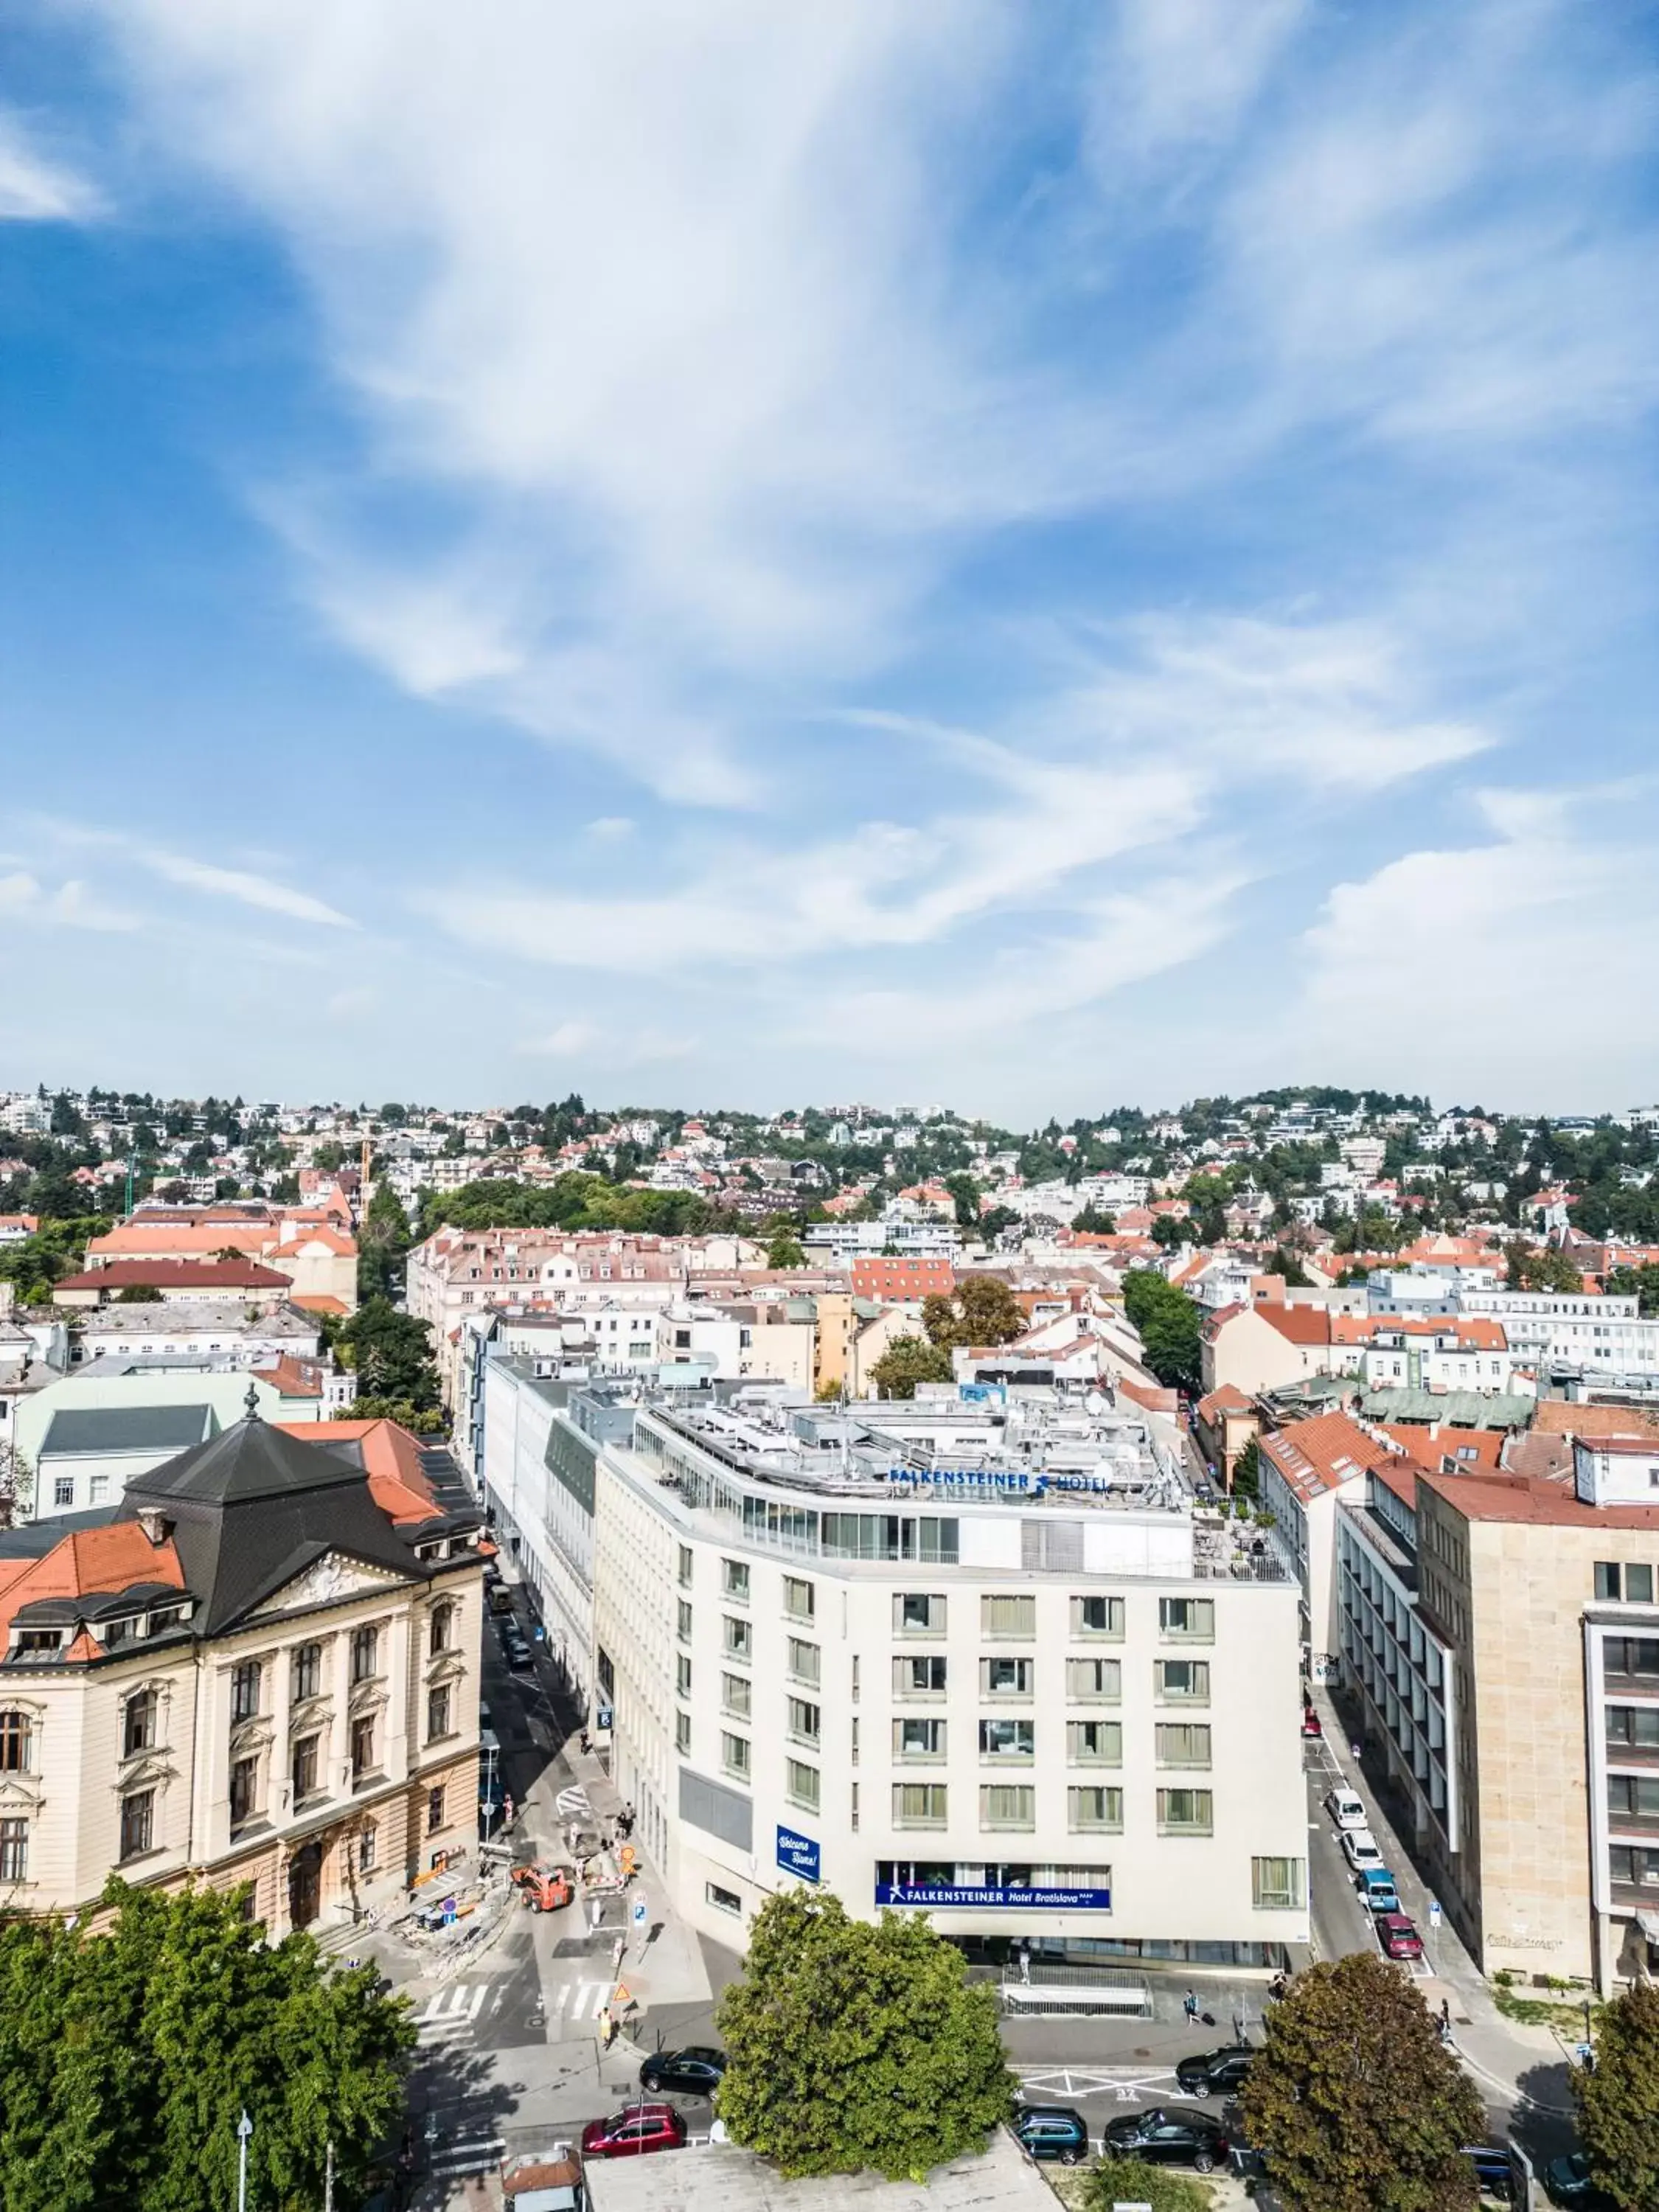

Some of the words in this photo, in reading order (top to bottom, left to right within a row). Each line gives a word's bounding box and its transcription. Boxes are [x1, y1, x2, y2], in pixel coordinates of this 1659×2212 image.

[890, 1470, 1029, 1487] FALKENSTEINER
[1057, 1475, 1109, 1493] HOTEL
[908, 1891, 1004, 1902] FALKENSTEINER
[1009, 1892, 1033, 1902] Hotel
[1035, 1893, 1078, 1903] Bratislava
